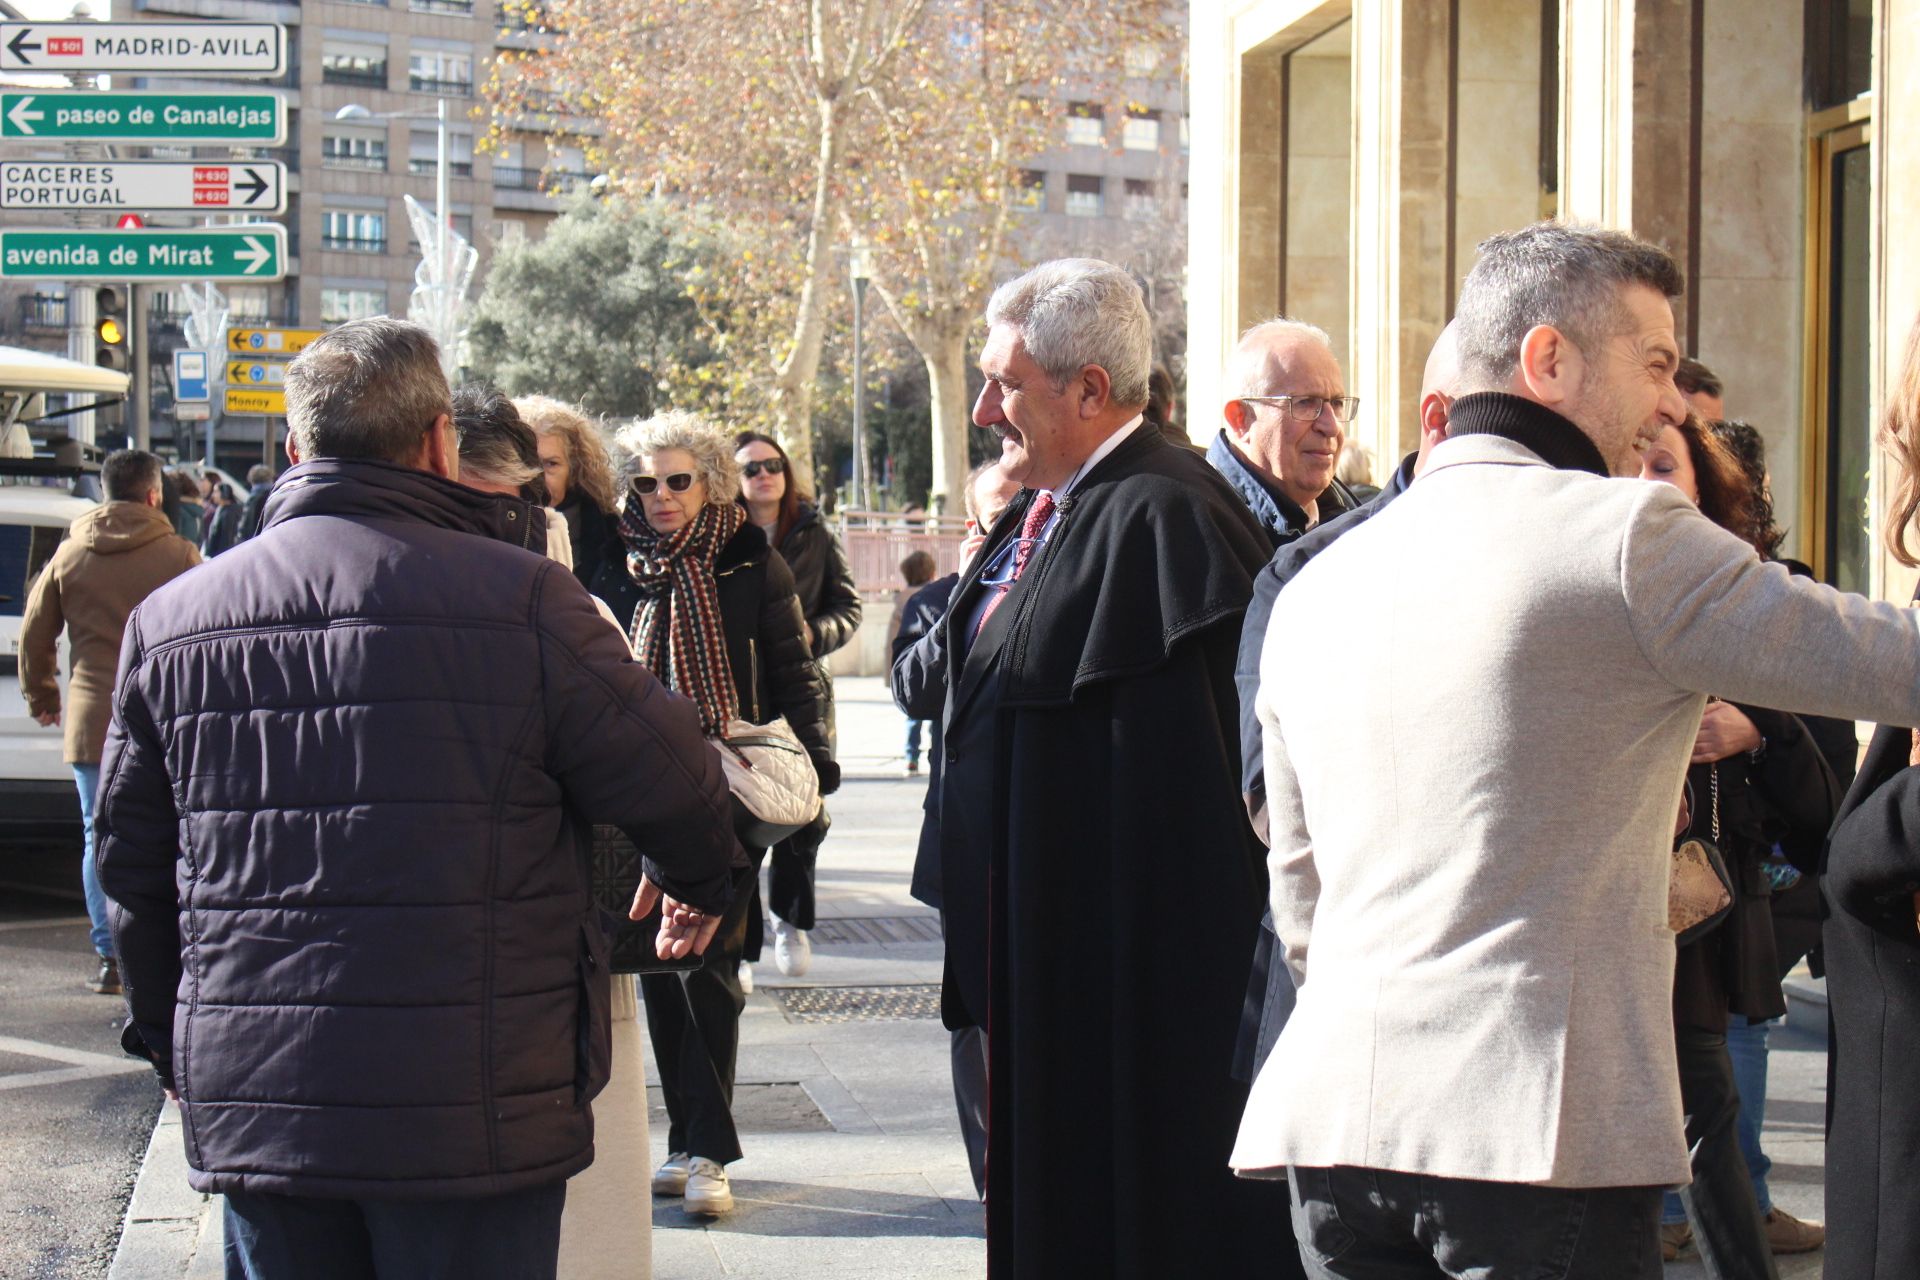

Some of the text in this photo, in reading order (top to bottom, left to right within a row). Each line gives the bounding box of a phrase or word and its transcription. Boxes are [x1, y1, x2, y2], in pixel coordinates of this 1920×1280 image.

[95, 38, 269, 56] MADRID-AVILA
[56, 105, 271, 128] paseo de Canalejas
[6, 167, 113, 184] CACERES
[6, 187, 125, 204] PORTUGAL
[6, 244, 214, 265] avenida de Mirat
